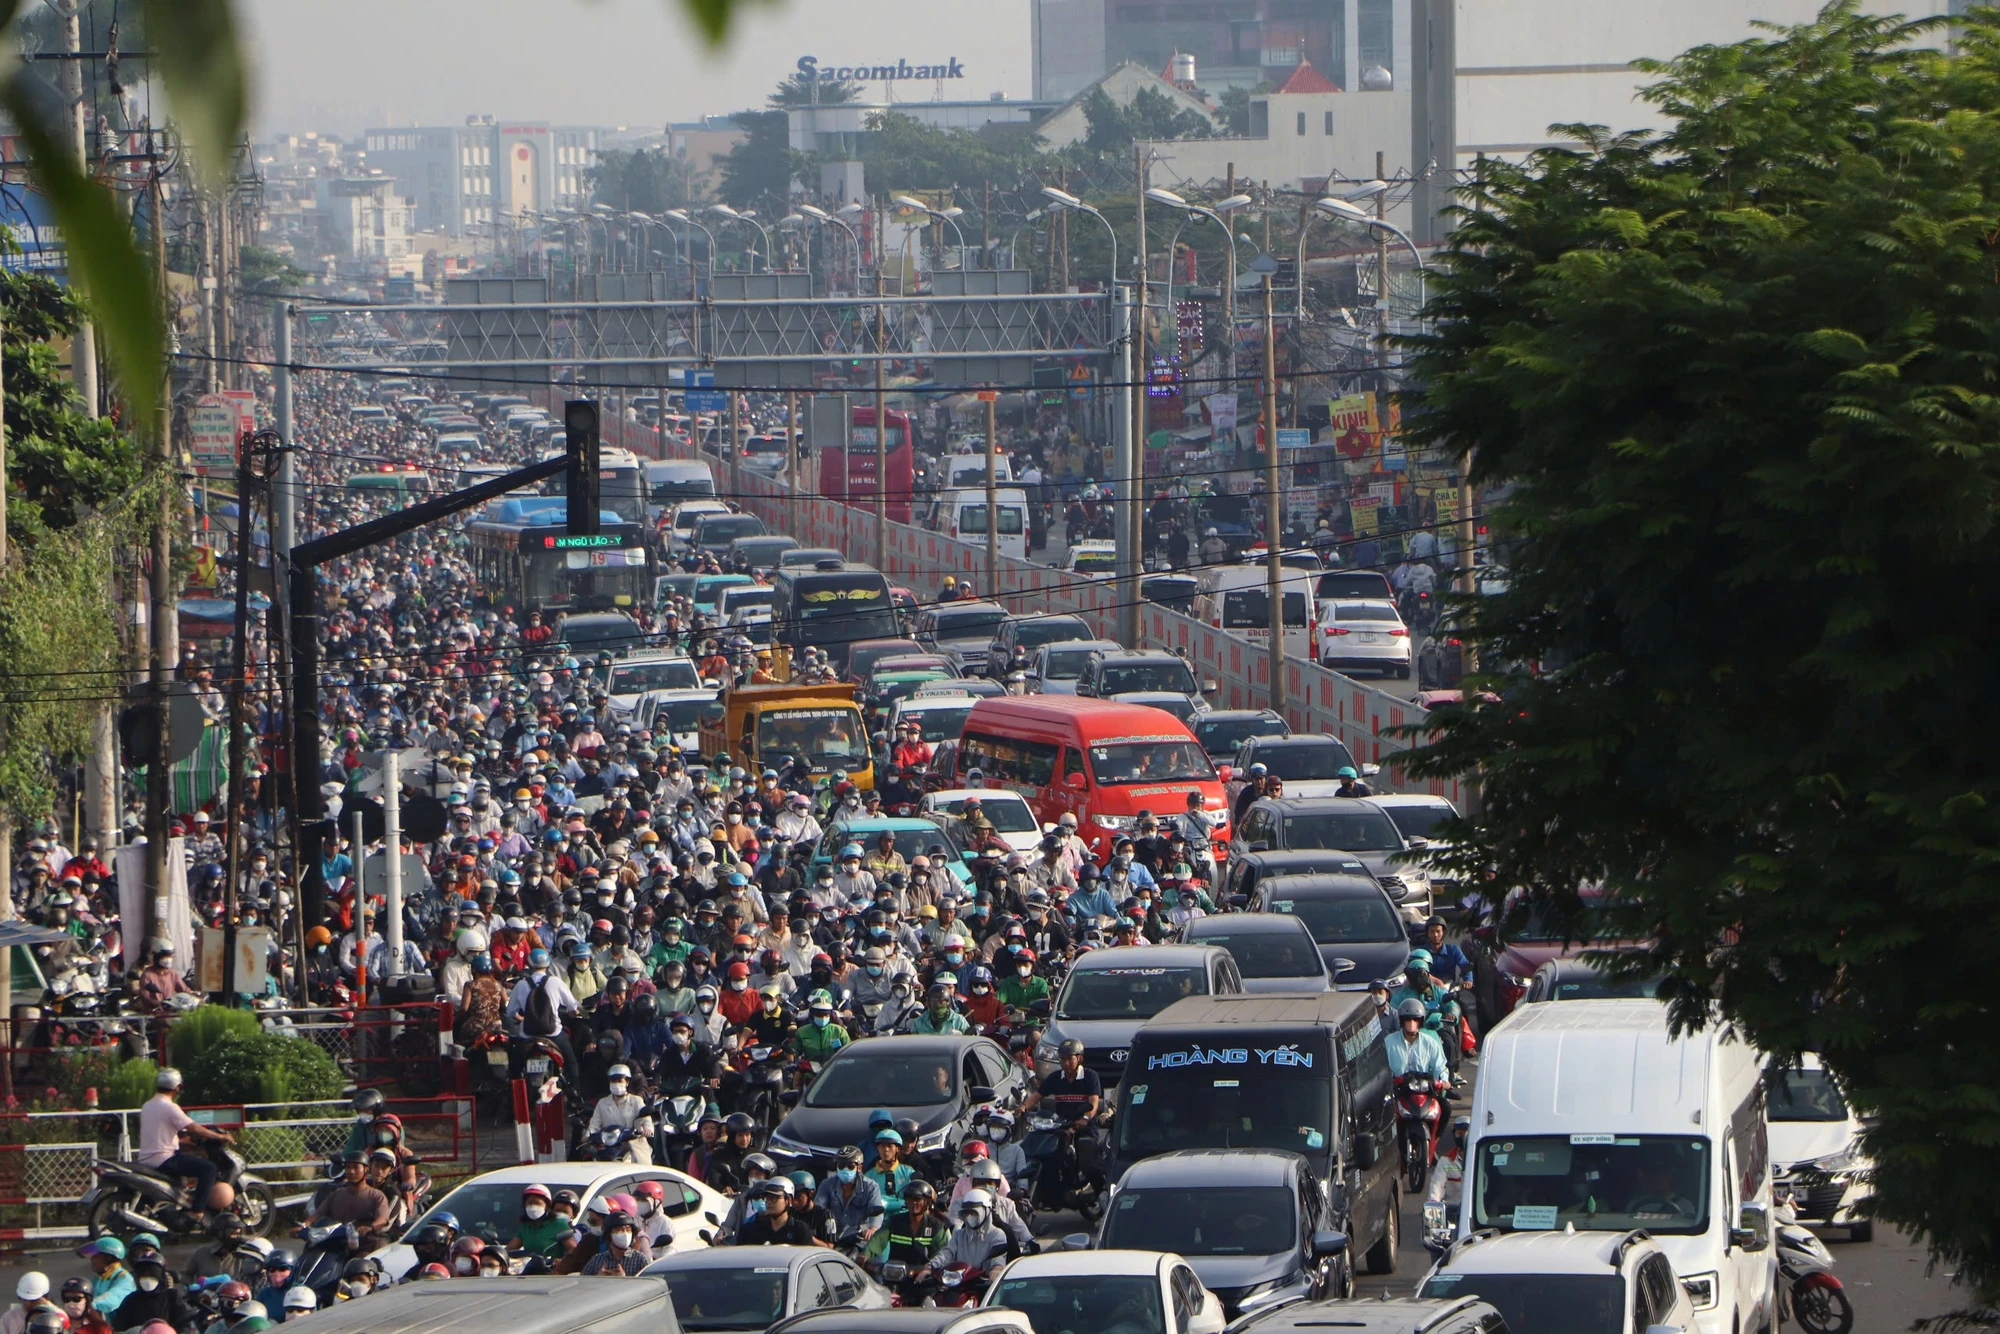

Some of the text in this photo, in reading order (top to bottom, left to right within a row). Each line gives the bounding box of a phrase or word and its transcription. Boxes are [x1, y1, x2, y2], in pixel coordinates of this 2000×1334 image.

[796, 55, 965, 82] Sacombank
[567, 536, 588, 547] NGŨ
[589, 535, 608, 546] LÃO
[591, 552, 606, 566] 19
[1148, 1044, 1313, 1071] HOÀNG YẾN
[1595, 1134, 1613, 1142] ĐỒNG
